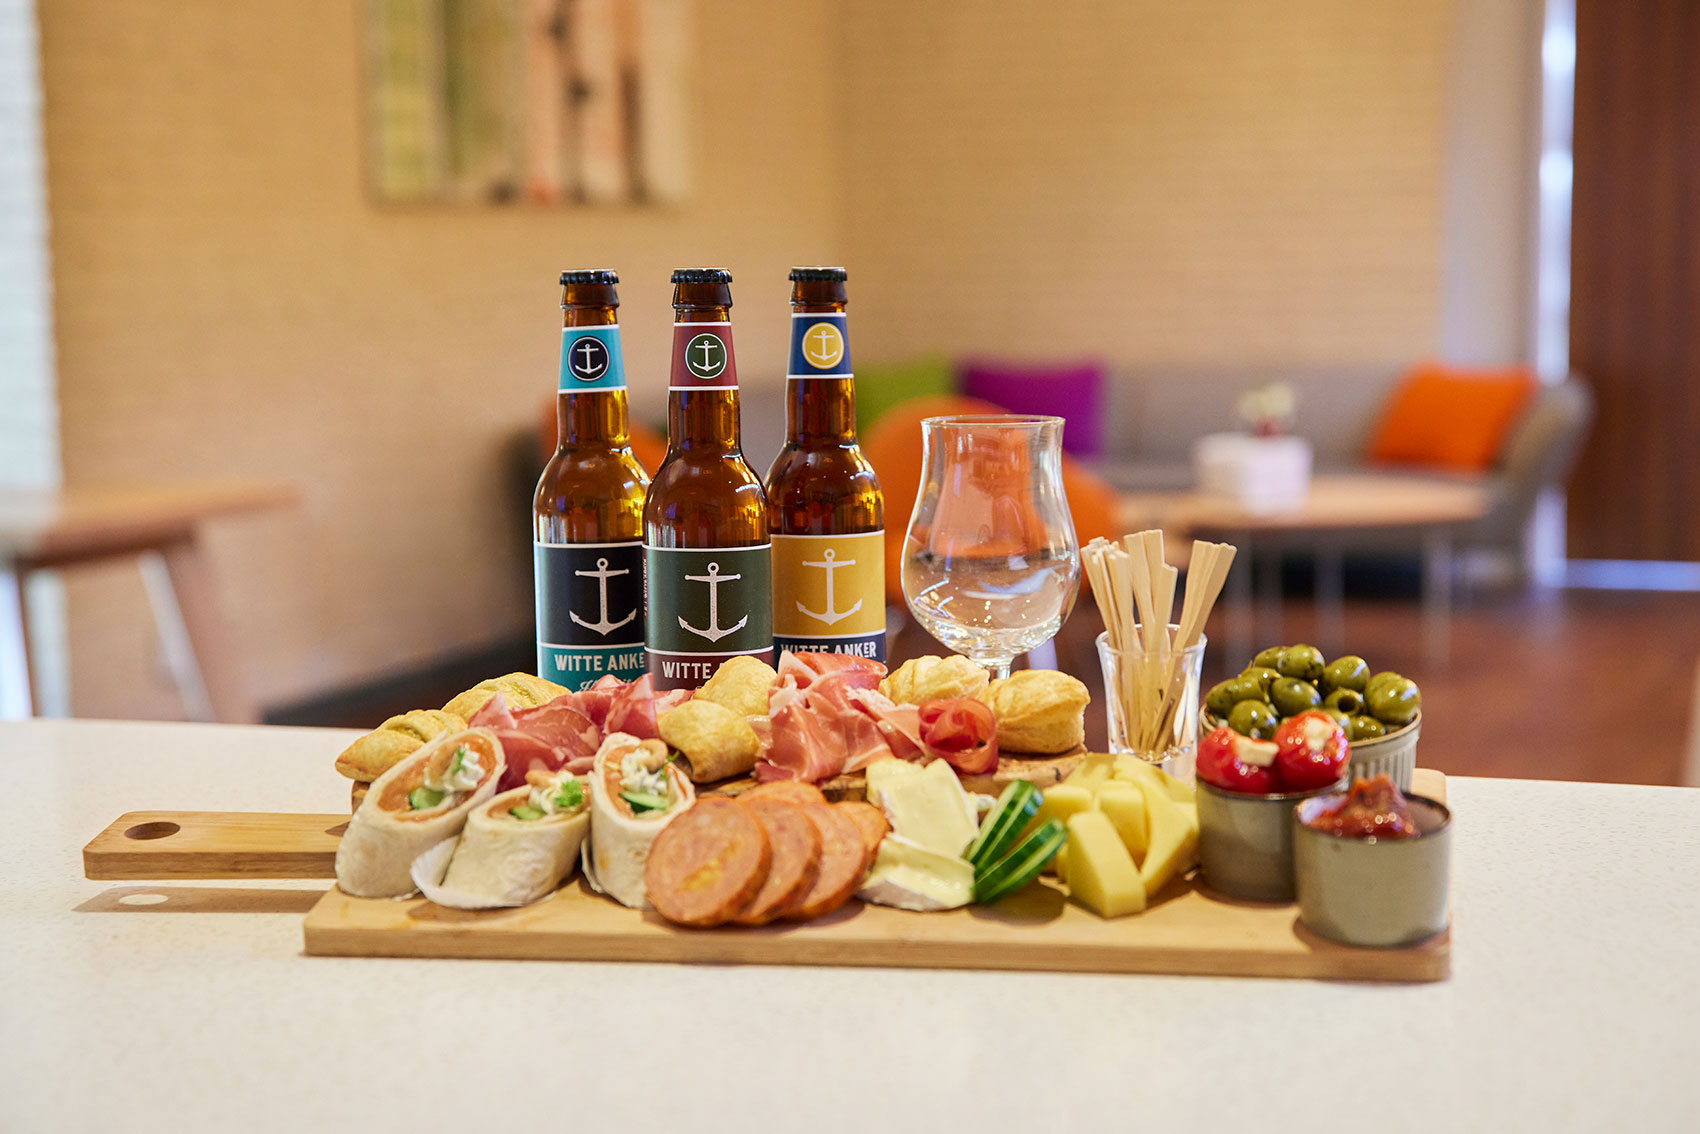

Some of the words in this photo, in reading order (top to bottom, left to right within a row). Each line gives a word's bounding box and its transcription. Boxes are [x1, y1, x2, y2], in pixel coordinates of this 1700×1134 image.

[834, 641, 877, 658] ANKER
[554, 653, 604, 672] WITTE
[607, 652, 645, 671] ANKE
[661, 660, 712, 680] WITTE
